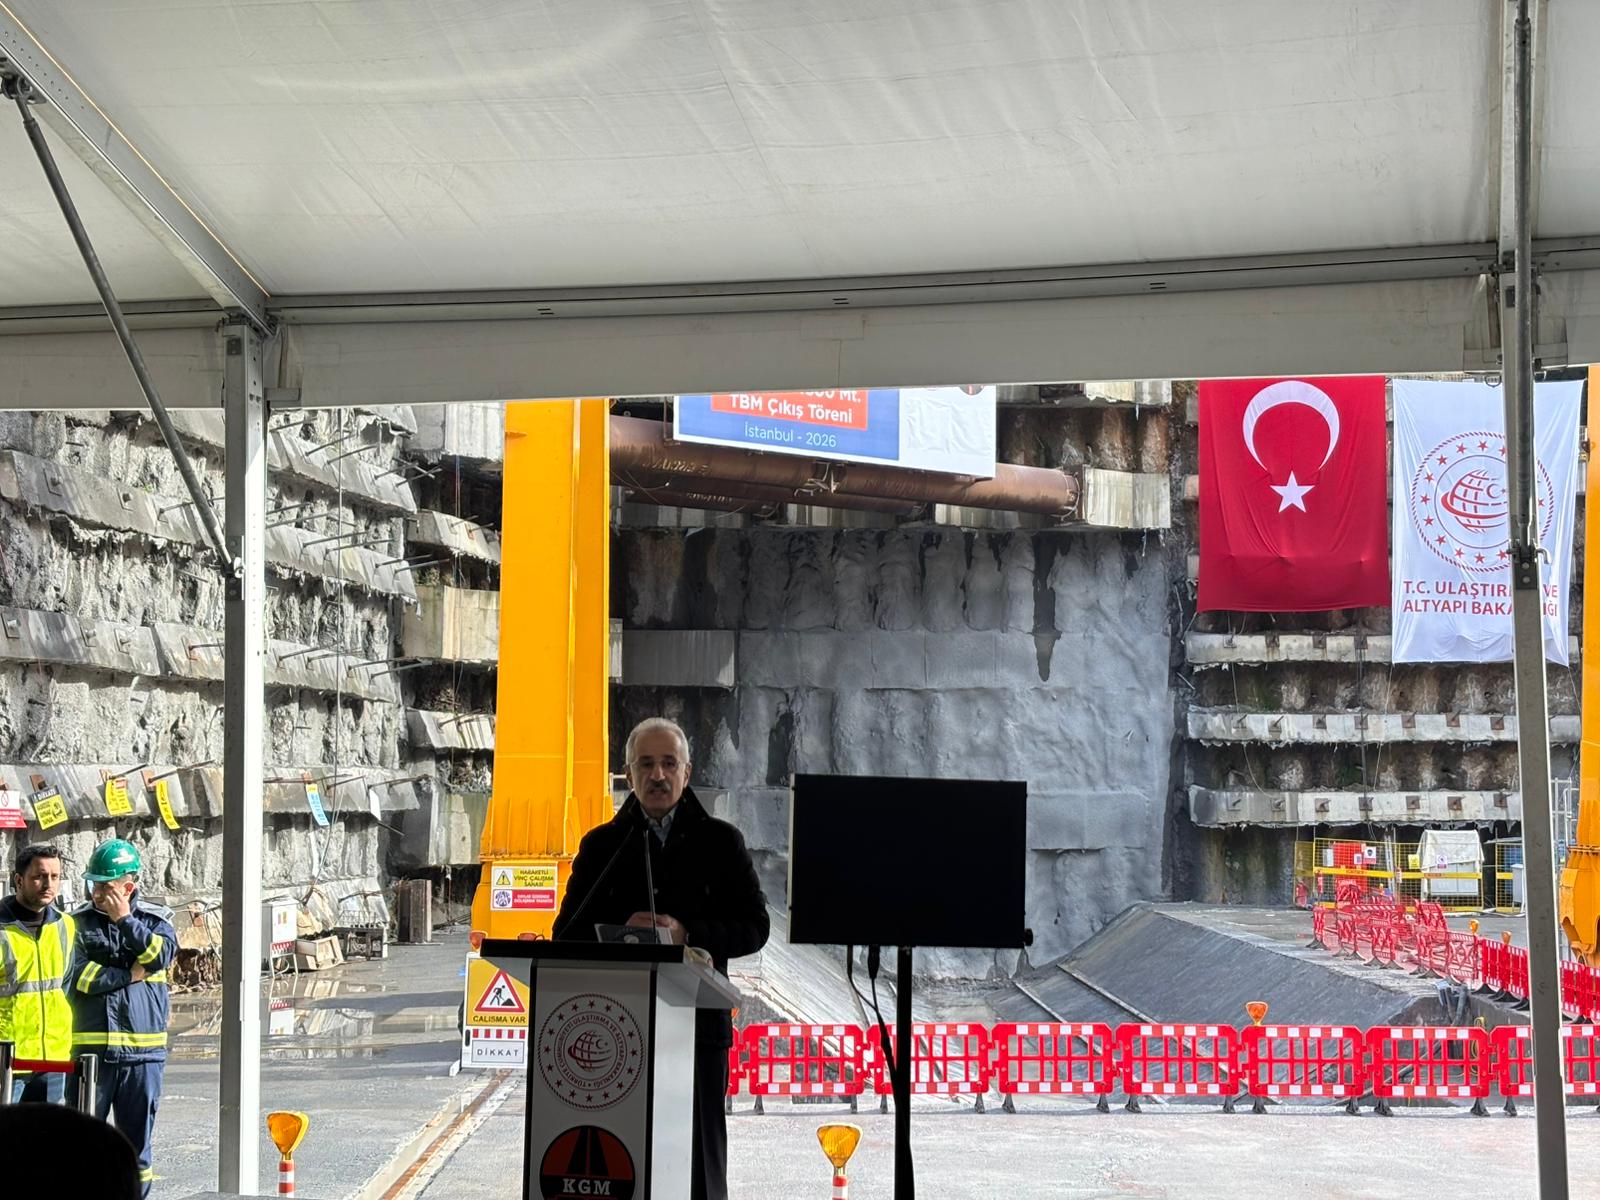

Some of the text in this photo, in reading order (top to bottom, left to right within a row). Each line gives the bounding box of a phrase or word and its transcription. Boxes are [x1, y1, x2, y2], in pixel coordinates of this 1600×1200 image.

[730, 394, 853, 423] TBM Çıkış Töreni
[745, 422, 794, 442] İstanbul
[806, 432, 836, 447] 2026
[1403, 581, 1558, 599] T.C. ULAŞTIR VE
[1403, 600, 1558, 616] ALTYAPI BAKIĞI
[509, 1015, 526, 1023] VAR
[477, 1048, 519, 1056] DİKKAT
[562, 1178, 611, 1195] KGM
